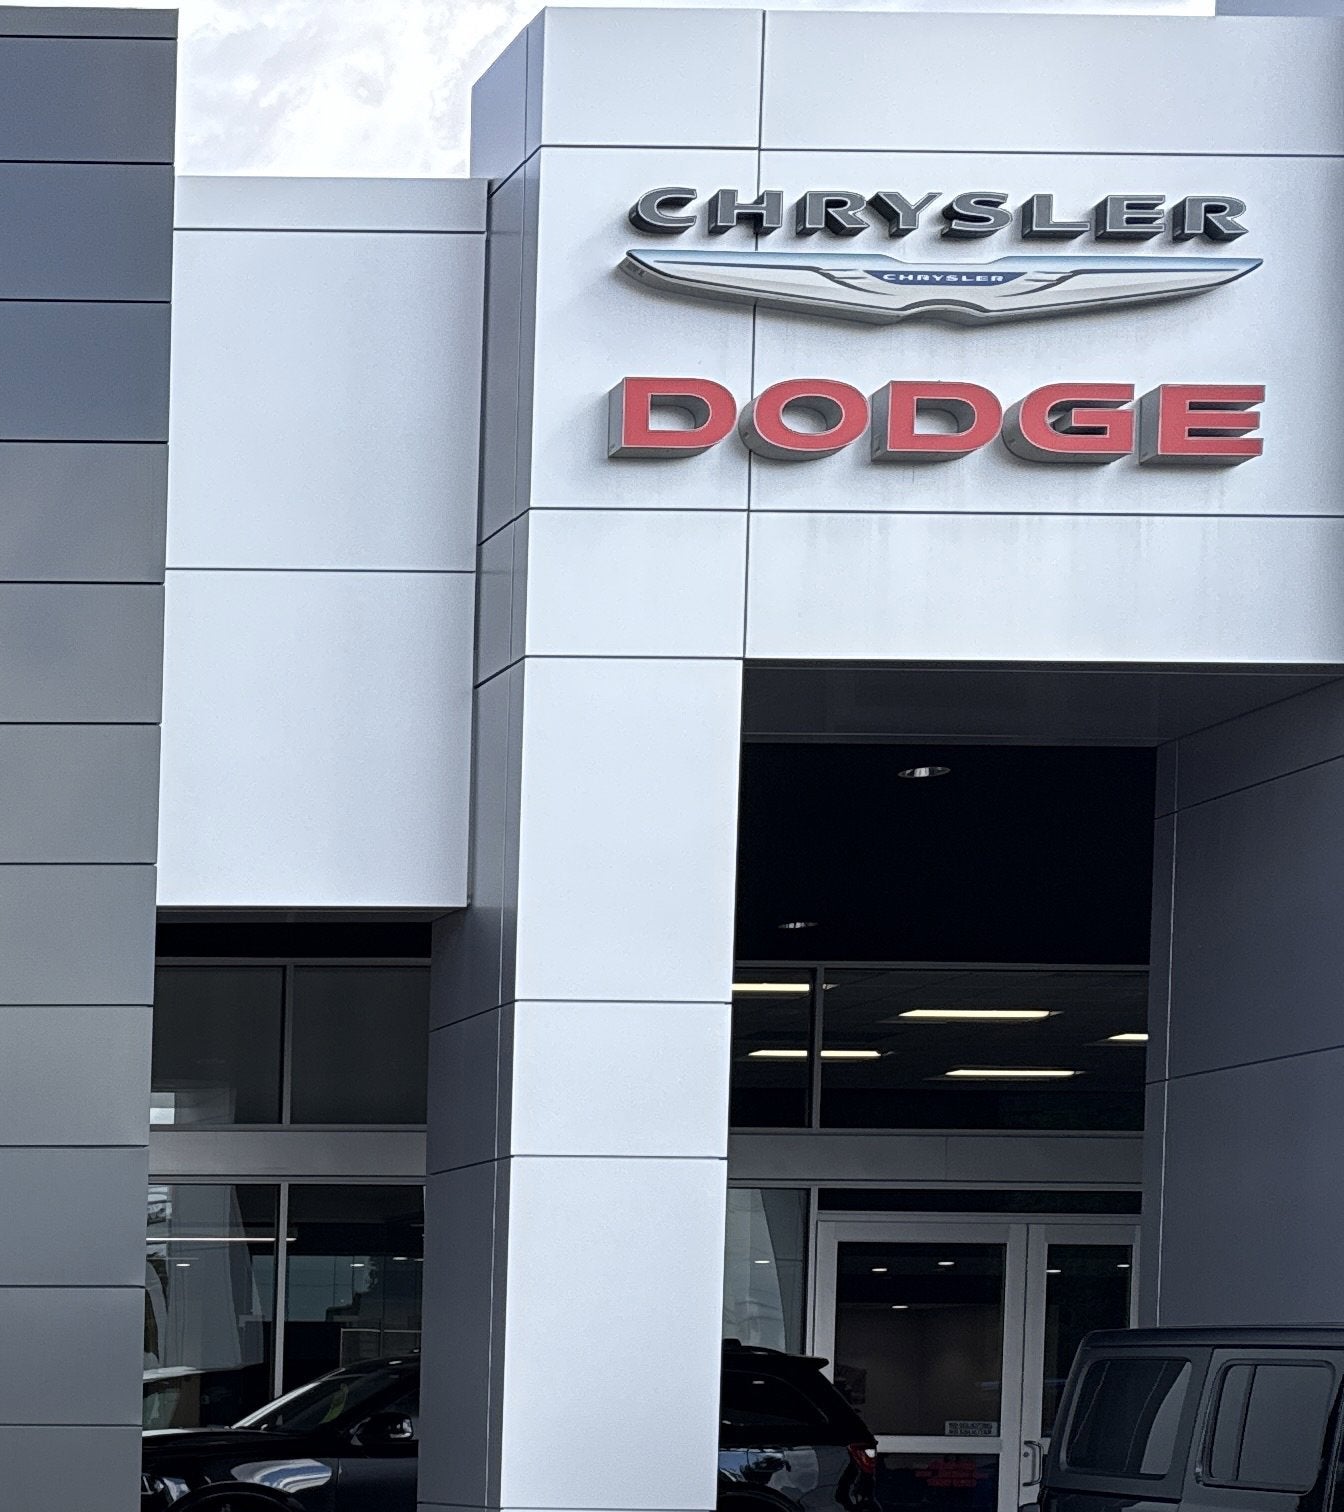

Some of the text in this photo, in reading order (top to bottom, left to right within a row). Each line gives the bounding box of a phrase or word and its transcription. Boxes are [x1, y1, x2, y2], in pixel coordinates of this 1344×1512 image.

[628, 187, 1249, 243] CHRYSLER
[882, 273, 1005, 283] CHRYSLER
[608, 376, 1266, 466] DODGE
